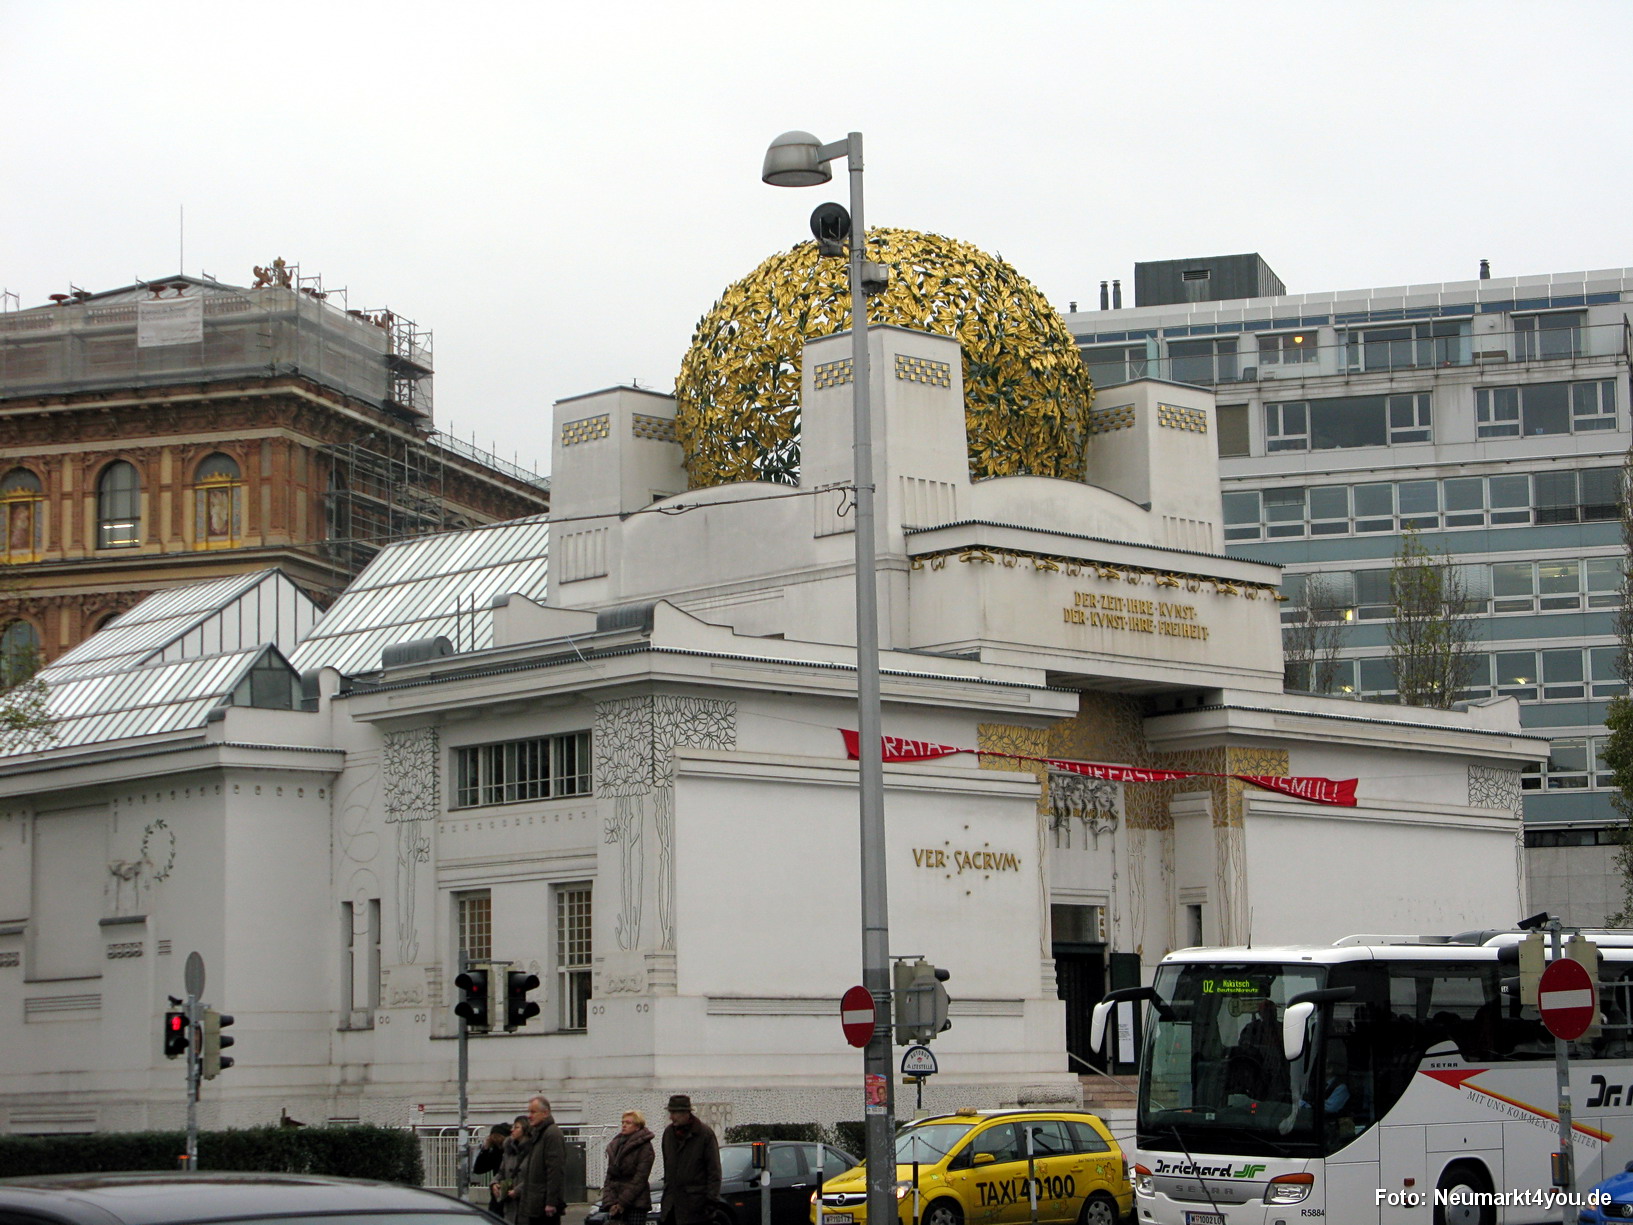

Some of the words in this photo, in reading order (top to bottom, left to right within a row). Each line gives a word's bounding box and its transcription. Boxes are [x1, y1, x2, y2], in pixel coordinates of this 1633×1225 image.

[1074, 592, 1097, 608] DER
[1101, 594, 1123, 611] ZEIT
[1127, 598, 1154, 616] IHRE
[1063, 608, 1085, 624] DER
[1128, 616, 1154, 633] IHRE
[1158, 620, 1208, 640] FREIHEIT
[912, 848, 946, 868] VER
[1203, 980, 1214, 993] 02
[1467, 1091, 1485, 1105] MIT
[1487, 1098, 1505, 1113] UNS
[1507, 1106, 1548, 1129] KOMMEN
[1549, 1123, 1559, 1135] SI
[1571, 1131, 1597, 1149] EITER
[976, 1179, 1017, 1206] TAXI
[1020, 1174, 1075, 1202] 40100
[1175, 1185, 1234, 1195] SETRA
